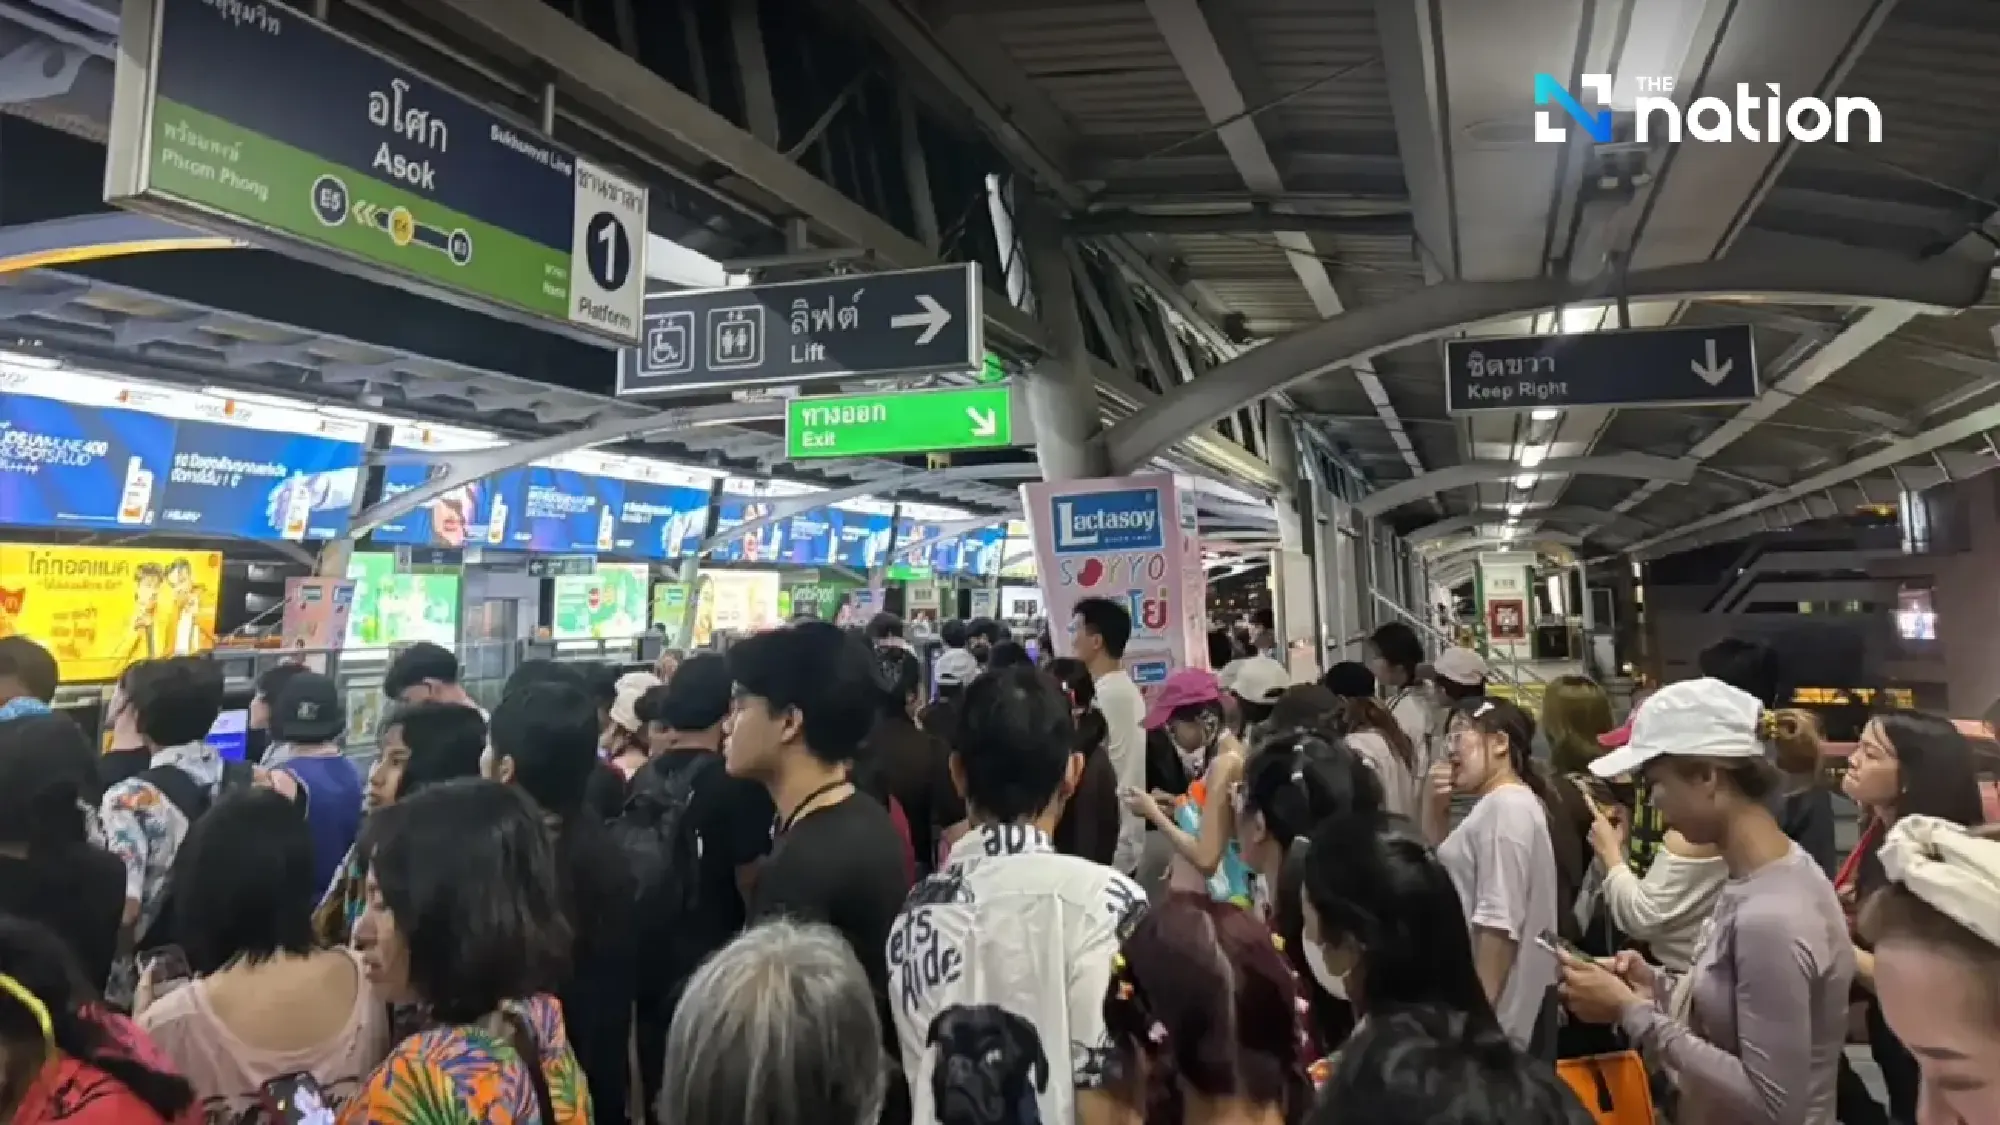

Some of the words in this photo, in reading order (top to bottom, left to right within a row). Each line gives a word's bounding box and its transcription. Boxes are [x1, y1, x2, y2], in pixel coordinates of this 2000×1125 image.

[369, 77, 447, 152] อโศก
[162, 147, 215, 180] Phrom
[219, 165, 270, 203] Phong
[372, 141, 436, 191] Asok
[598, 219, 616, 283] 1
[577, 296, 633, 331] Platform
[791, 287, 866, 335] ลิฟต์
[791, 342, 826, 364] Lift
[1466, 350, 1556, 378] ชิดขวา
[1467, 383, 1513, 401] Keep
[1519, 381, 1569, 400] Right
[802, 402, 887, 427] ทางออก
[802, 430, 836, 448] Exit
[1057, 502, 1156, 547] Lactasoy
